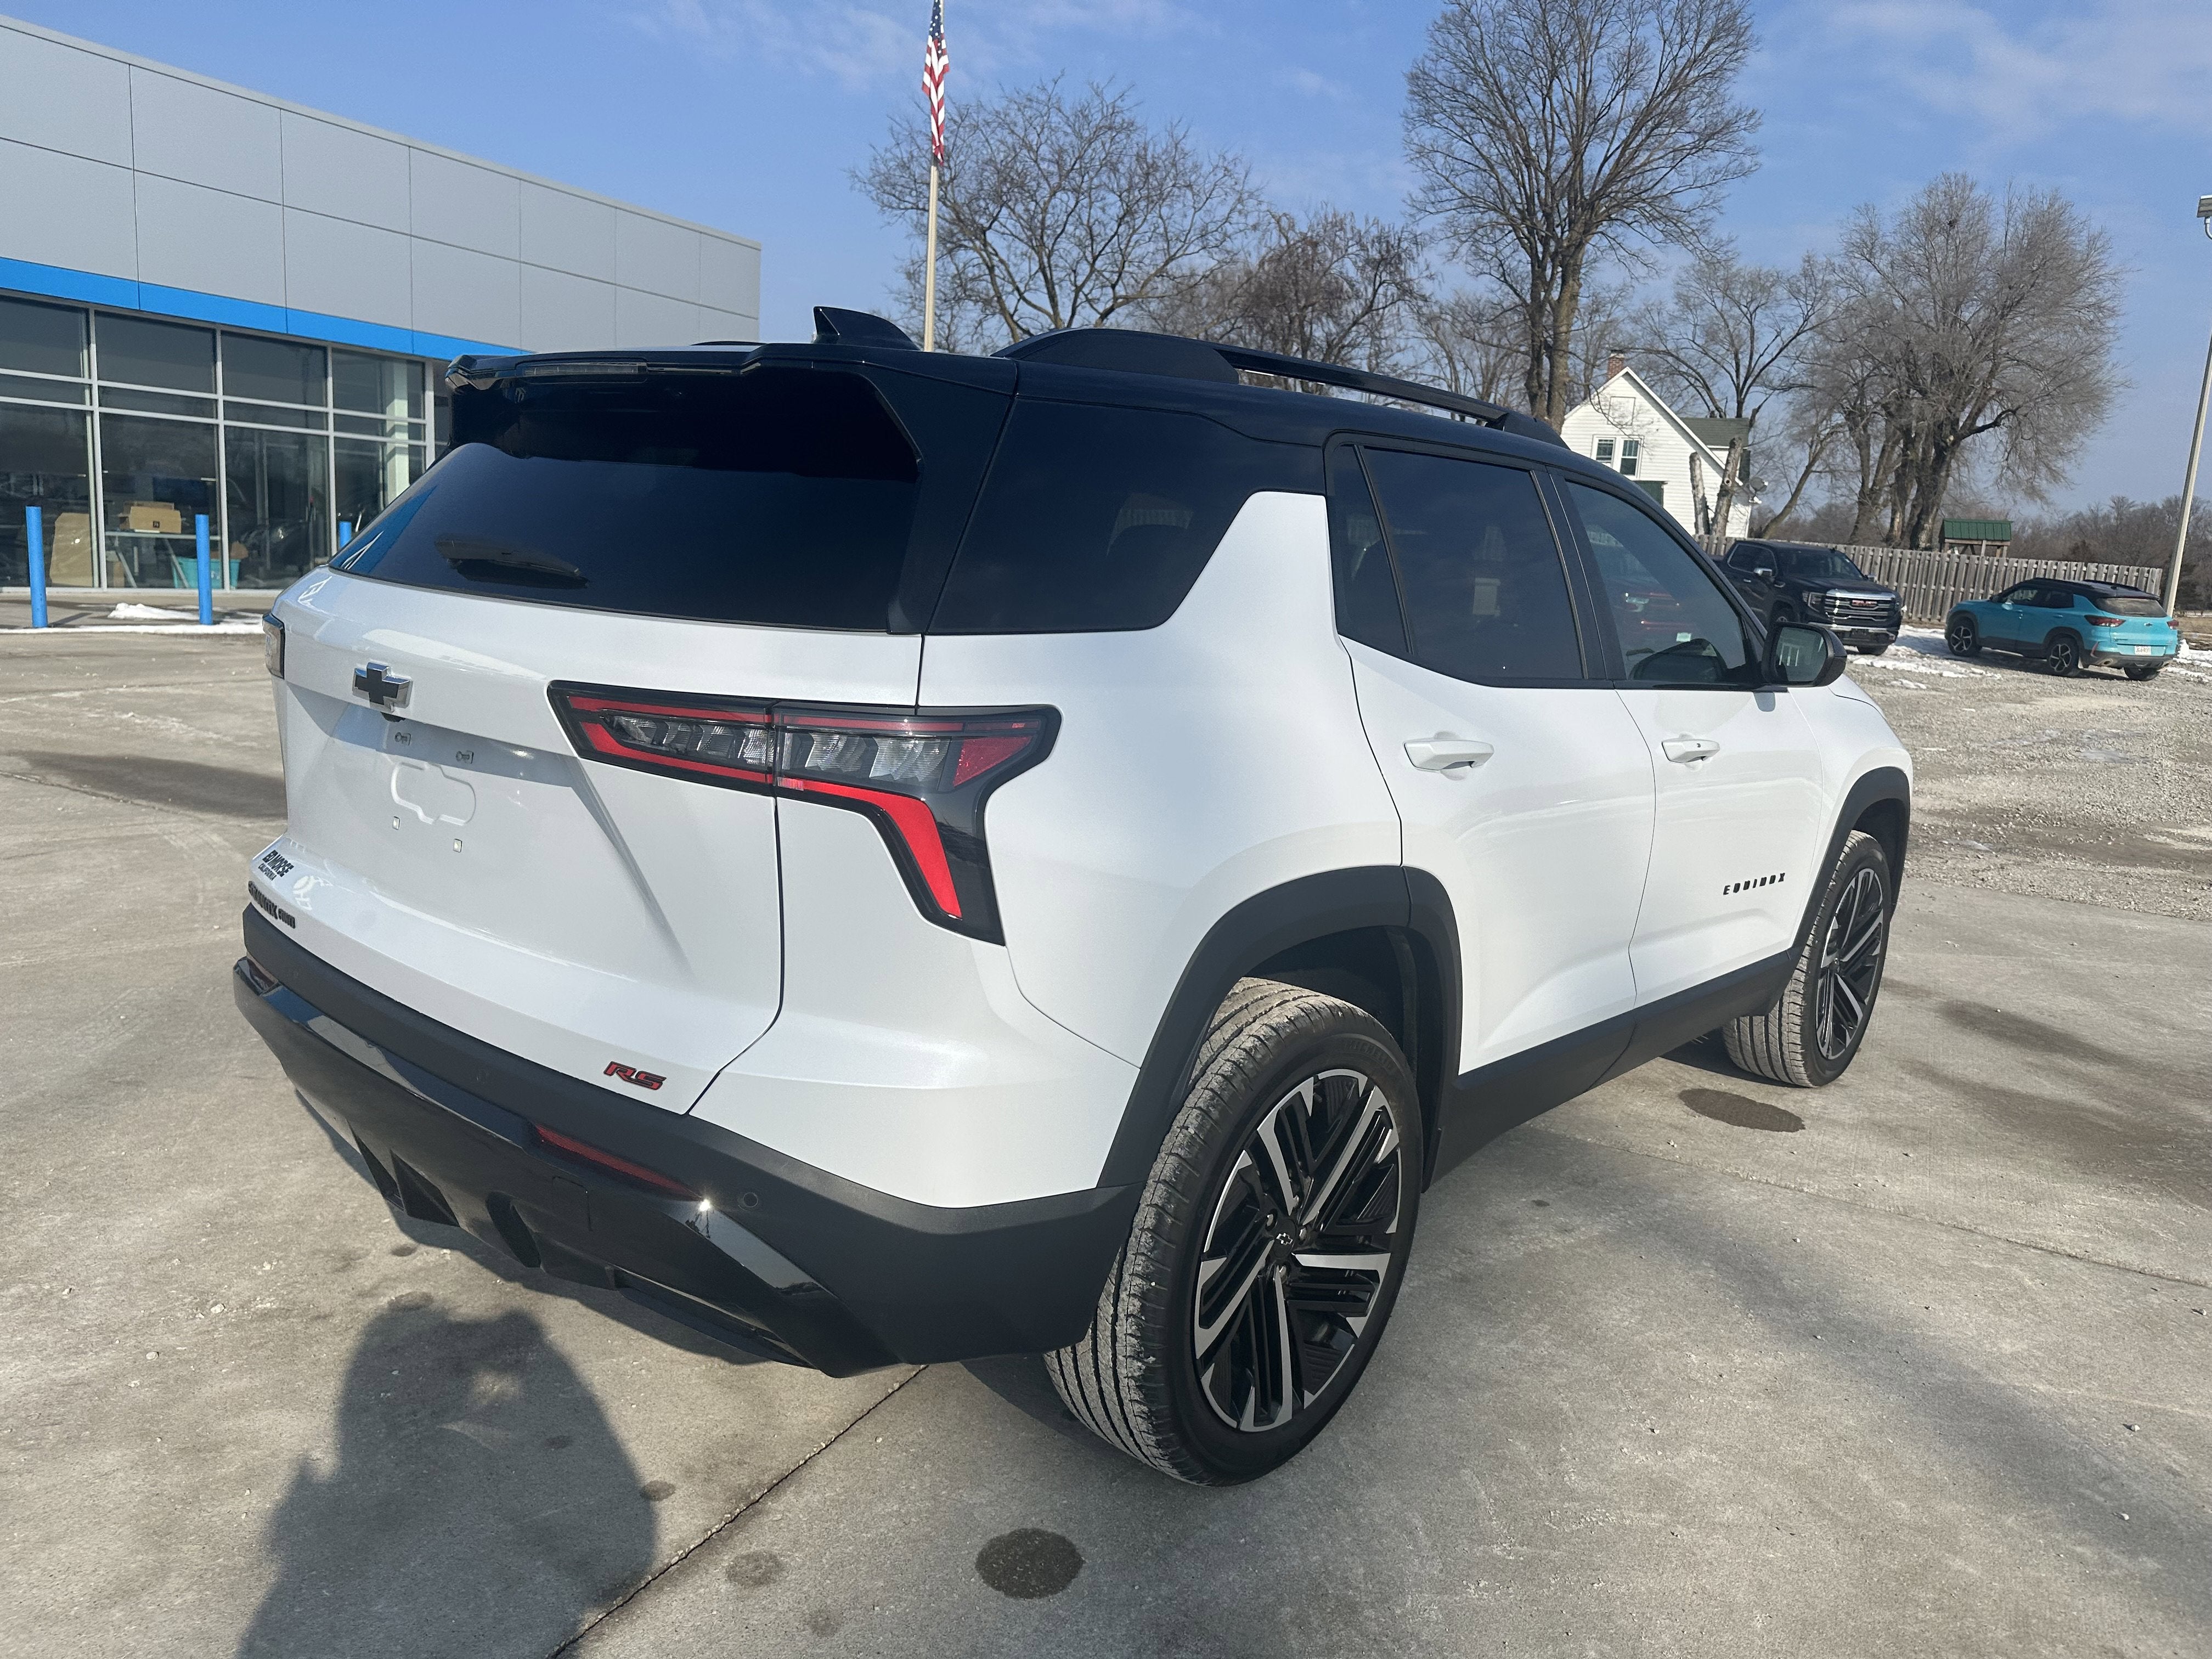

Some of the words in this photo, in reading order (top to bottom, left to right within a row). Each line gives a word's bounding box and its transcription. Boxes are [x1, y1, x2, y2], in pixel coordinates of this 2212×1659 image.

[262, 850, 278, 862] ED
[267, 854, 294, 877] MORSE
[1723, 872, 1786, 895] EQUINOX
[603, 1061, 667, 1090] RS
